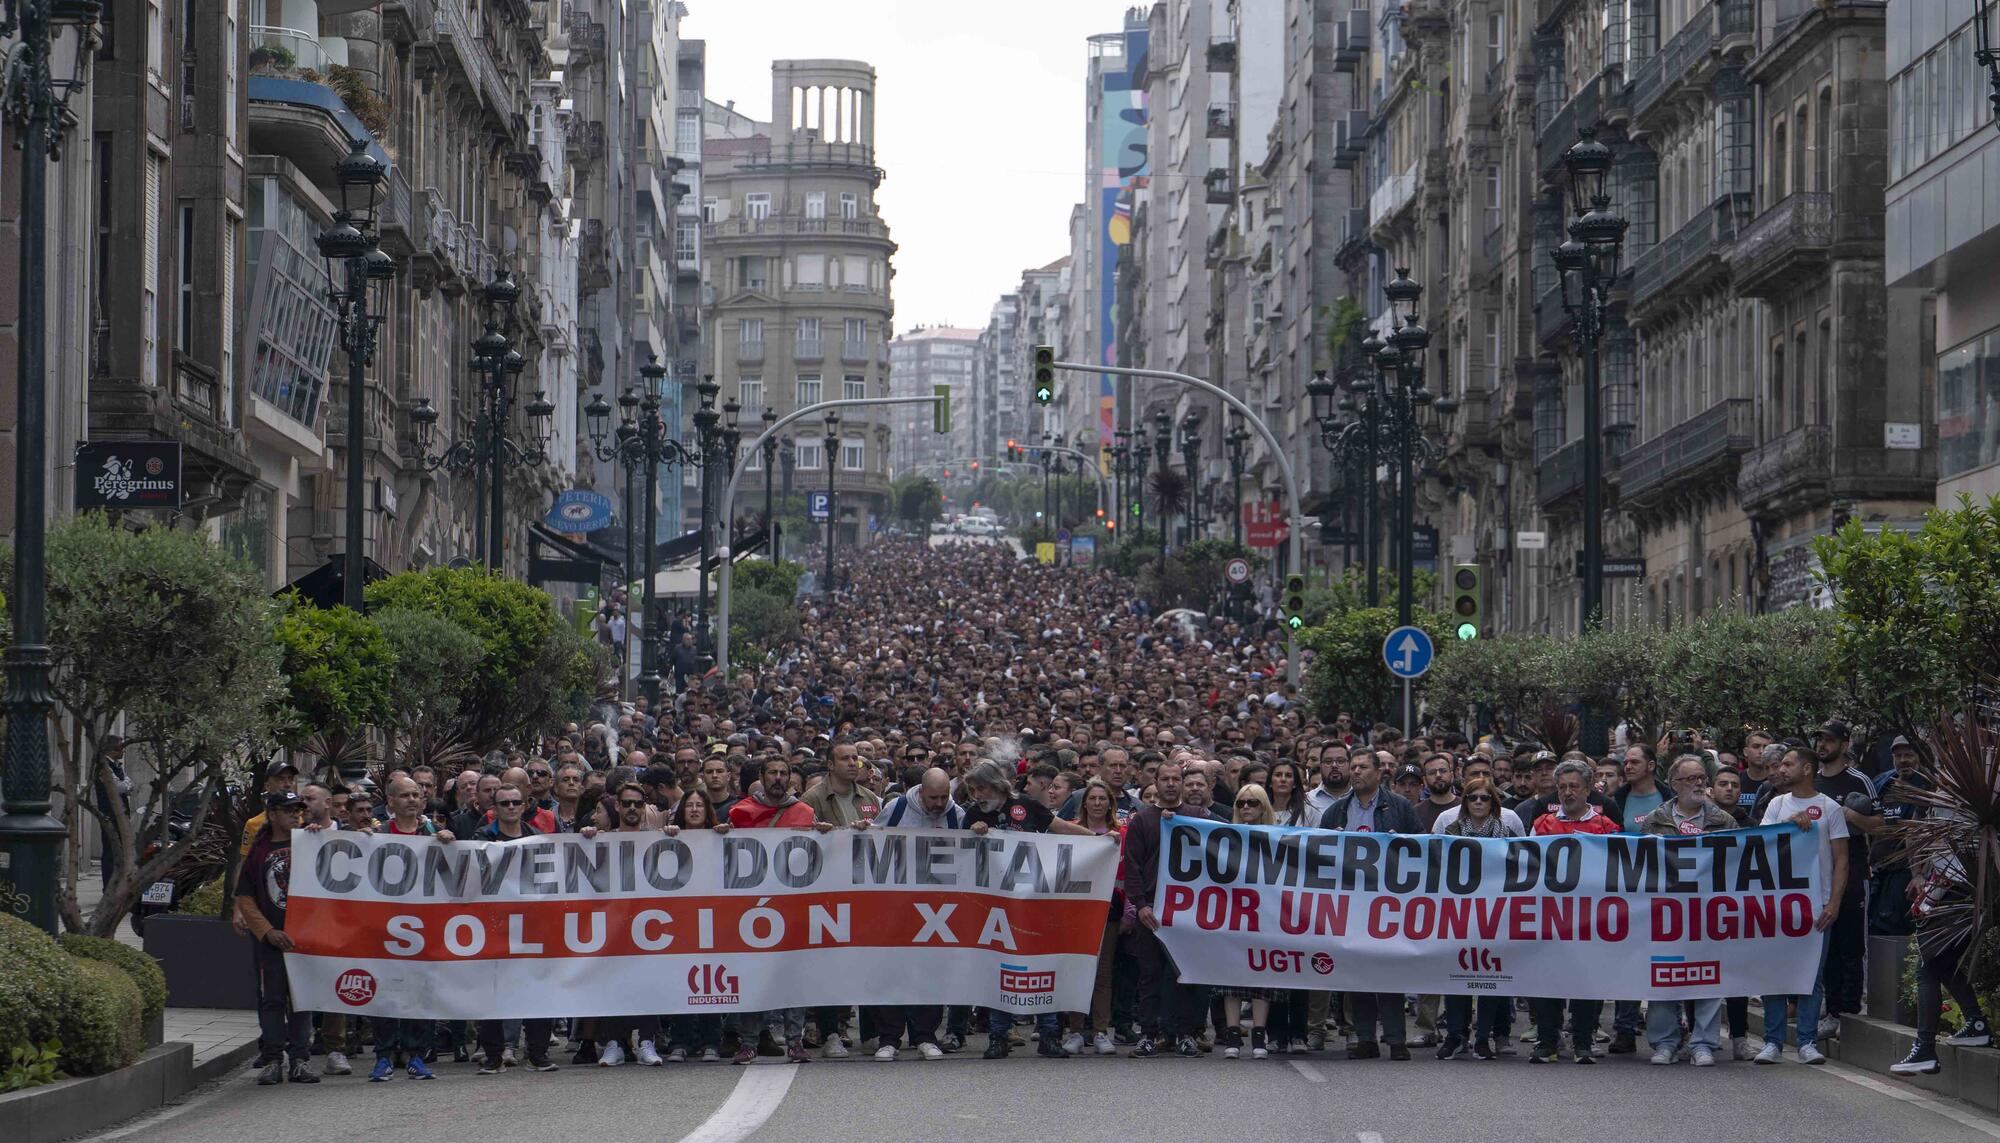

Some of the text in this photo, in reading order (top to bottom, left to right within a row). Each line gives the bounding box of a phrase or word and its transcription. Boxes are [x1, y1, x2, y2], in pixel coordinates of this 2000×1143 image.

[94, 477, 174, 492] Peregrinus
[1231, 566, 1245, 574] 40
[1602, 564, 1642, 572] BERSHKA
[315, 833, 1092, 897] CONVENIO DO METAL
[1168, 824, 1810, 895] COMERCIO DO METAL
[1161, 884, 1814, 942] POR UN CONVENIO DIGNO
[383, 897, 1018, 957] SOLUCIÓN XA
[1247, 948, 1305, 973] UGT
[1458, 947, 1502, 972] CIG
[340, 974, 371, 991] UGT
[688, 963, 739, 994] CIG
[1003, 974, 1052, 989] CCOO
[1655, 965, 1716, 983] CCOO
[1467, 982, 1497, 990] SERVIZOS
[689, 996, 738, 1004] INDUSTRIA
[1001, 993, 1052, 1006] industria
